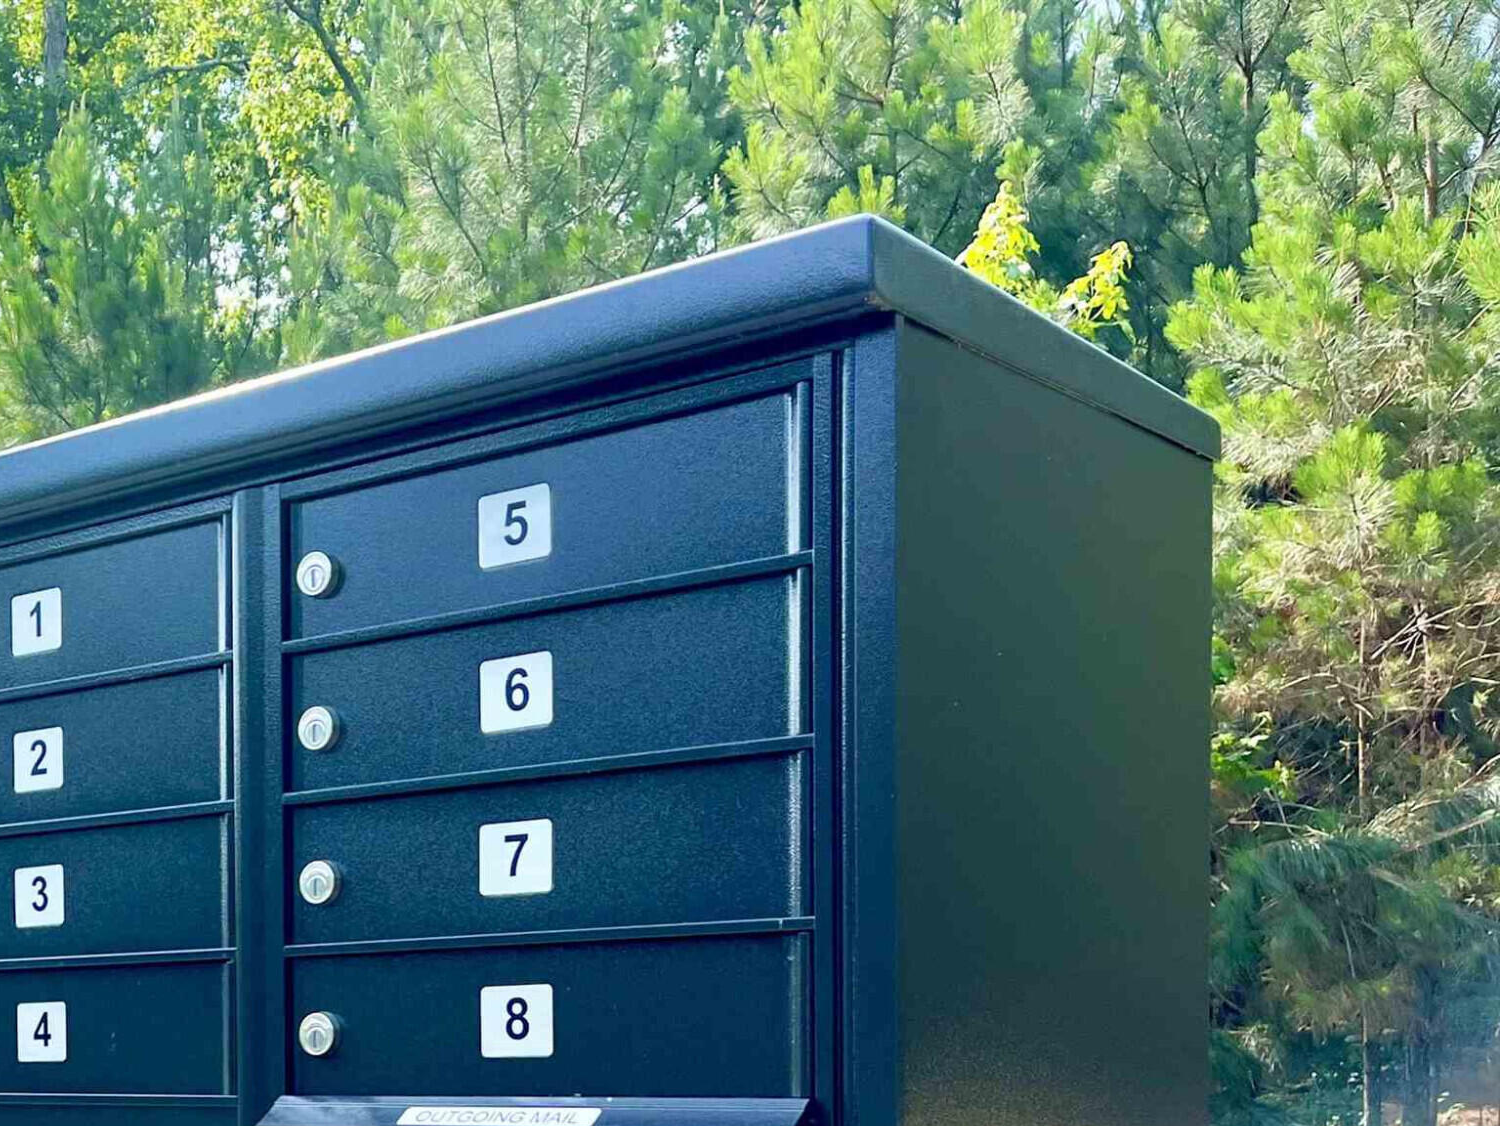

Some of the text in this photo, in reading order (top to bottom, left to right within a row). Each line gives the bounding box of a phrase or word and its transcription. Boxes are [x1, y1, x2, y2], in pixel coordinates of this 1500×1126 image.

[503, 500, 529, 546] 5
[29, 601, 42, 637] 1
[504, 667, 530, 711] 6
[30, 739, 47, 776] 2
[504, 833, 529, 877] 7
[31, 876, 49, 912] 3
[33, 1011, 51, 1047] 4
[505, 997, 530, 1040] 8
[415, 1110, 580, 1125] OUTGOING MAIL
